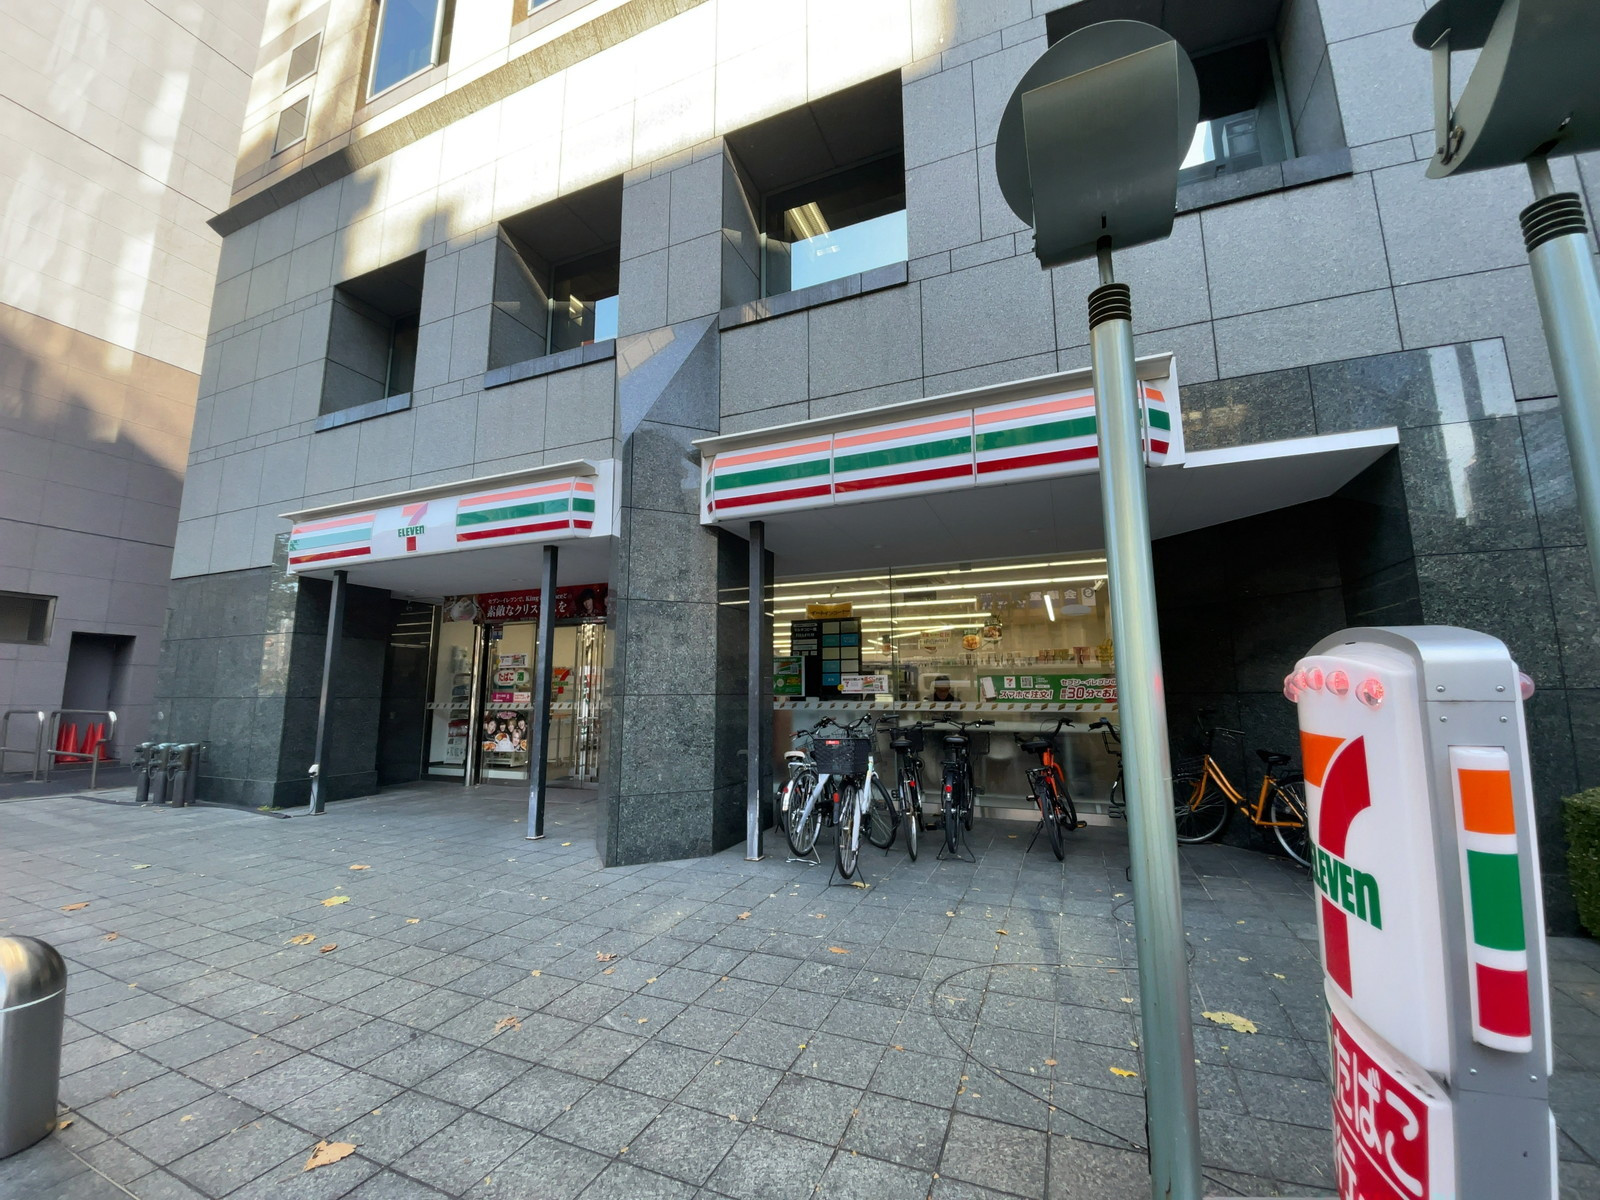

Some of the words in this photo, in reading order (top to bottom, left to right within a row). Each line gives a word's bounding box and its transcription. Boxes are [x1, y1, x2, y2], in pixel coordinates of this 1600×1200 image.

[498, 672, 514, 682] たばこ
[1333, 1028, 1424, 1198] たばこ
